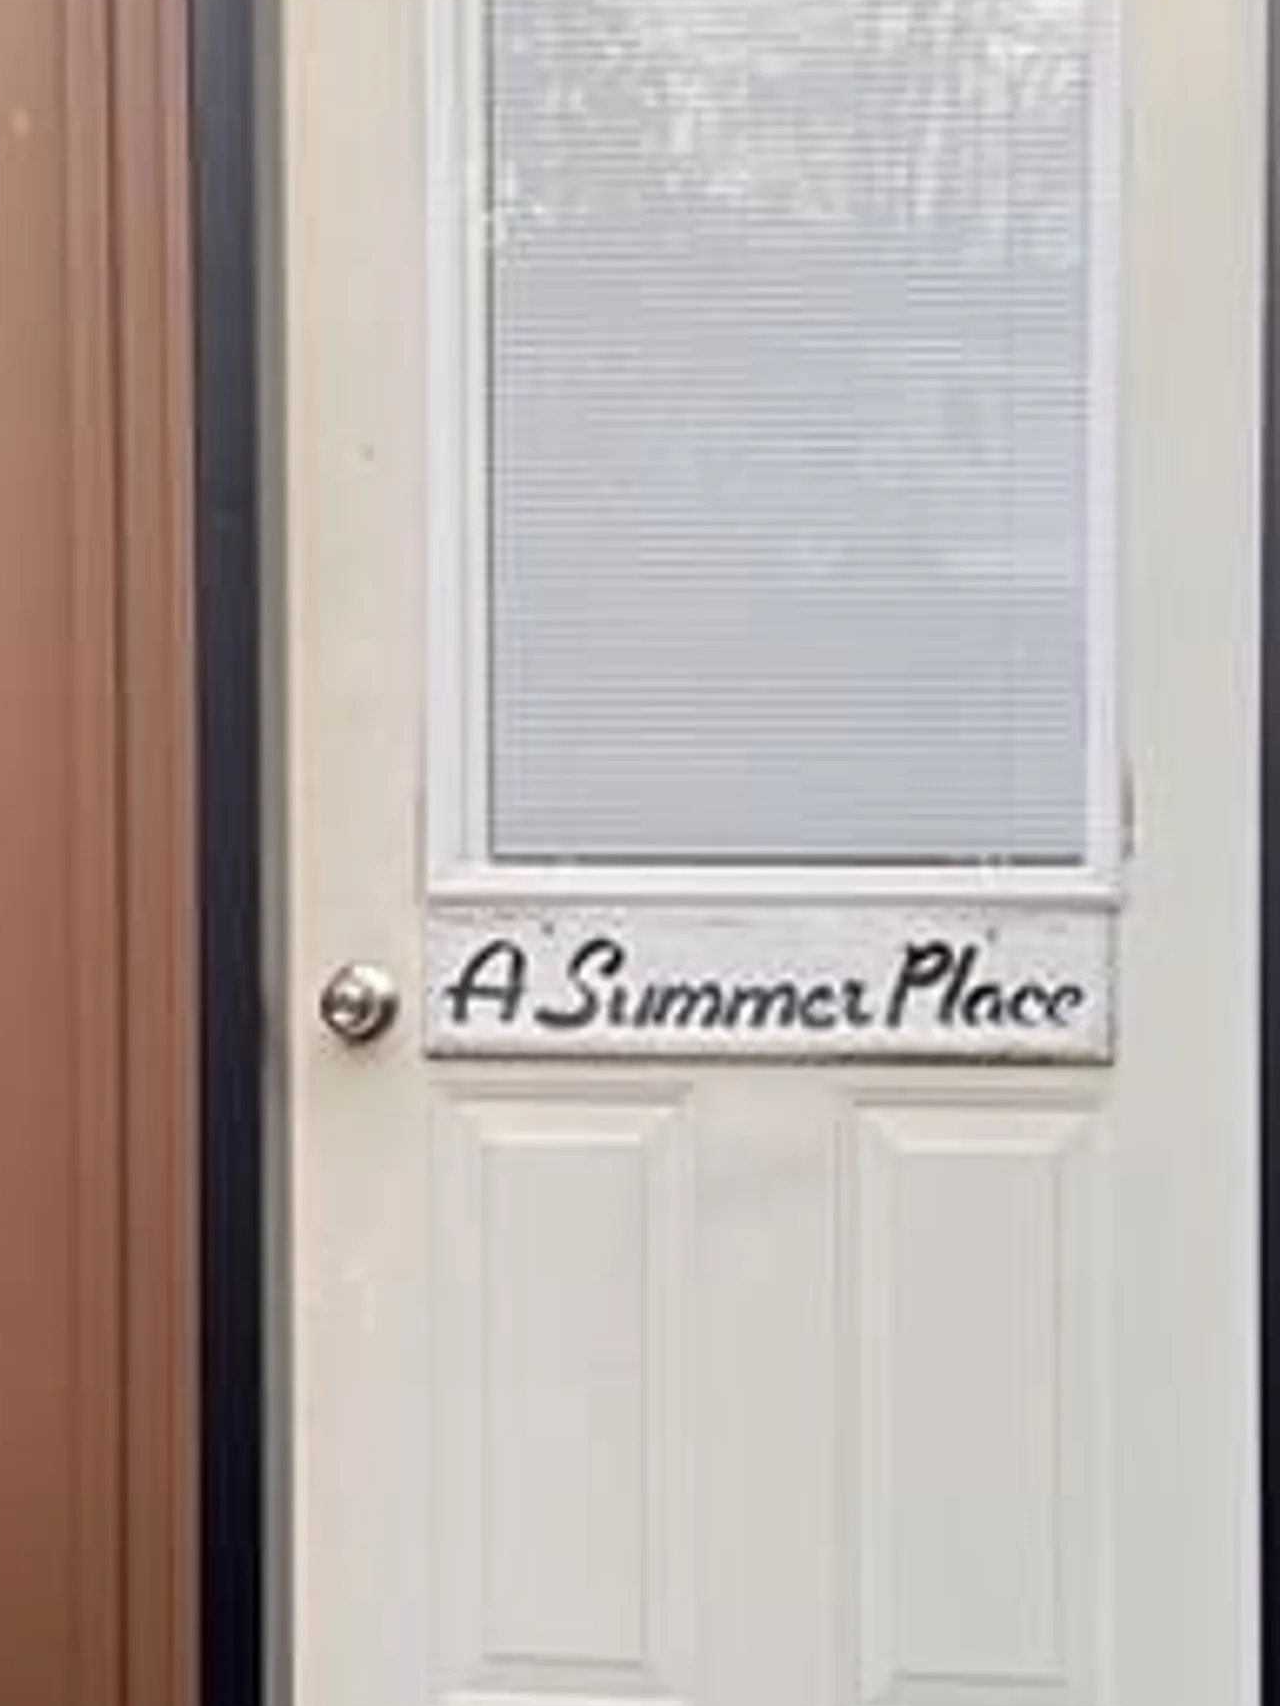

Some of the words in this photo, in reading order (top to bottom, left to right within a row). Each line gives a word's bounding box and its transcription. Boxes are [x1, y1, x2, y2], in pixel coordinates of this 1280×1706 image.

[442, 938, 527, 1027] A
[533, 936, 874, 1029] Summer
[885, 939, 1086, 1029] Place
